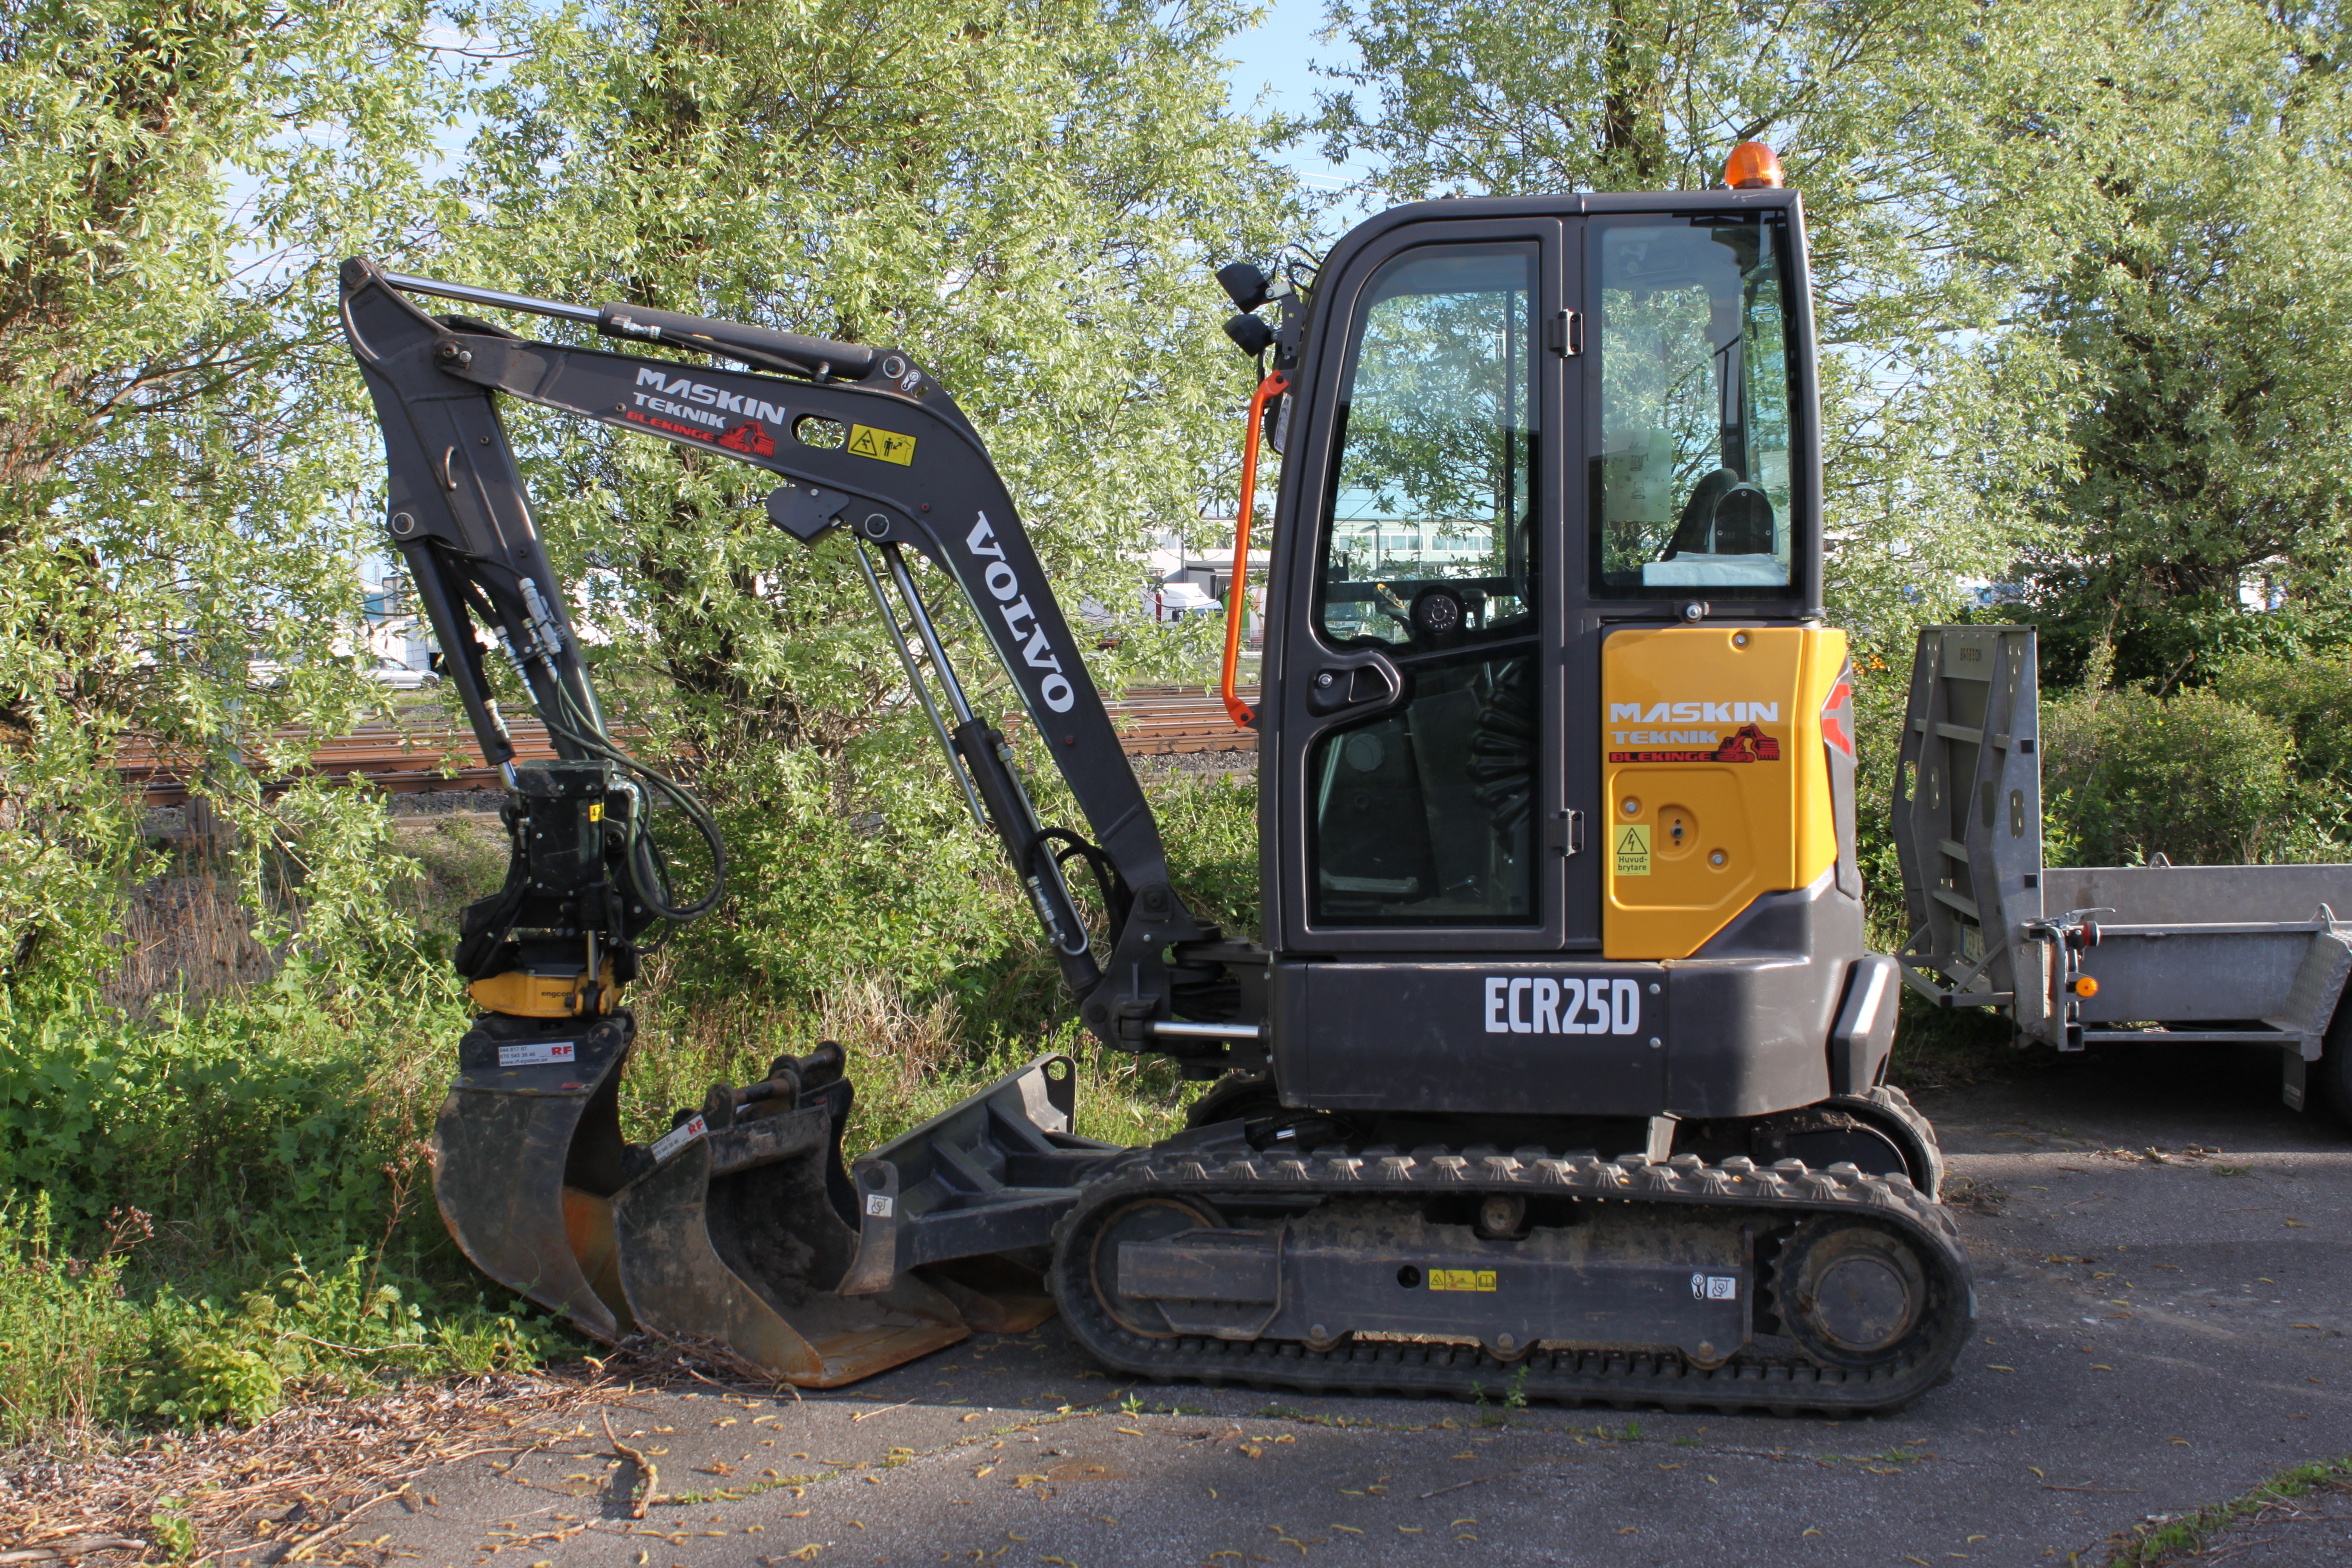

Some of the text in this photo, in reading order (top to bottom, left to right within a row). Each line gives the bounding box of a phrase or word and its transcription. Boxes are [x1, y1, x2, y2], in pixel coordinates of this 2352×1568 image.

[635, 367, 786, 425] MASKIN
[633, 391, 727, 430] TEKNIK
[625, 410, 715, 442] BLEKINGE
[966, 510, 1075, 713] VOLVO
[1610, 701, 1778, 723] MASKIN
[1610, 730, 1718, 744] TEKNIK
[1611, 752, 1713, 762] BLEKINGE
[1617, 864, 1647, 872] brytare
[1618, 855, 1648, 863] Huvud-
[1485, 977, 1640, 1035] ECR25D
[551, 1046, 572, 1056] RF
[687, 1119, 704, 1135] RF
